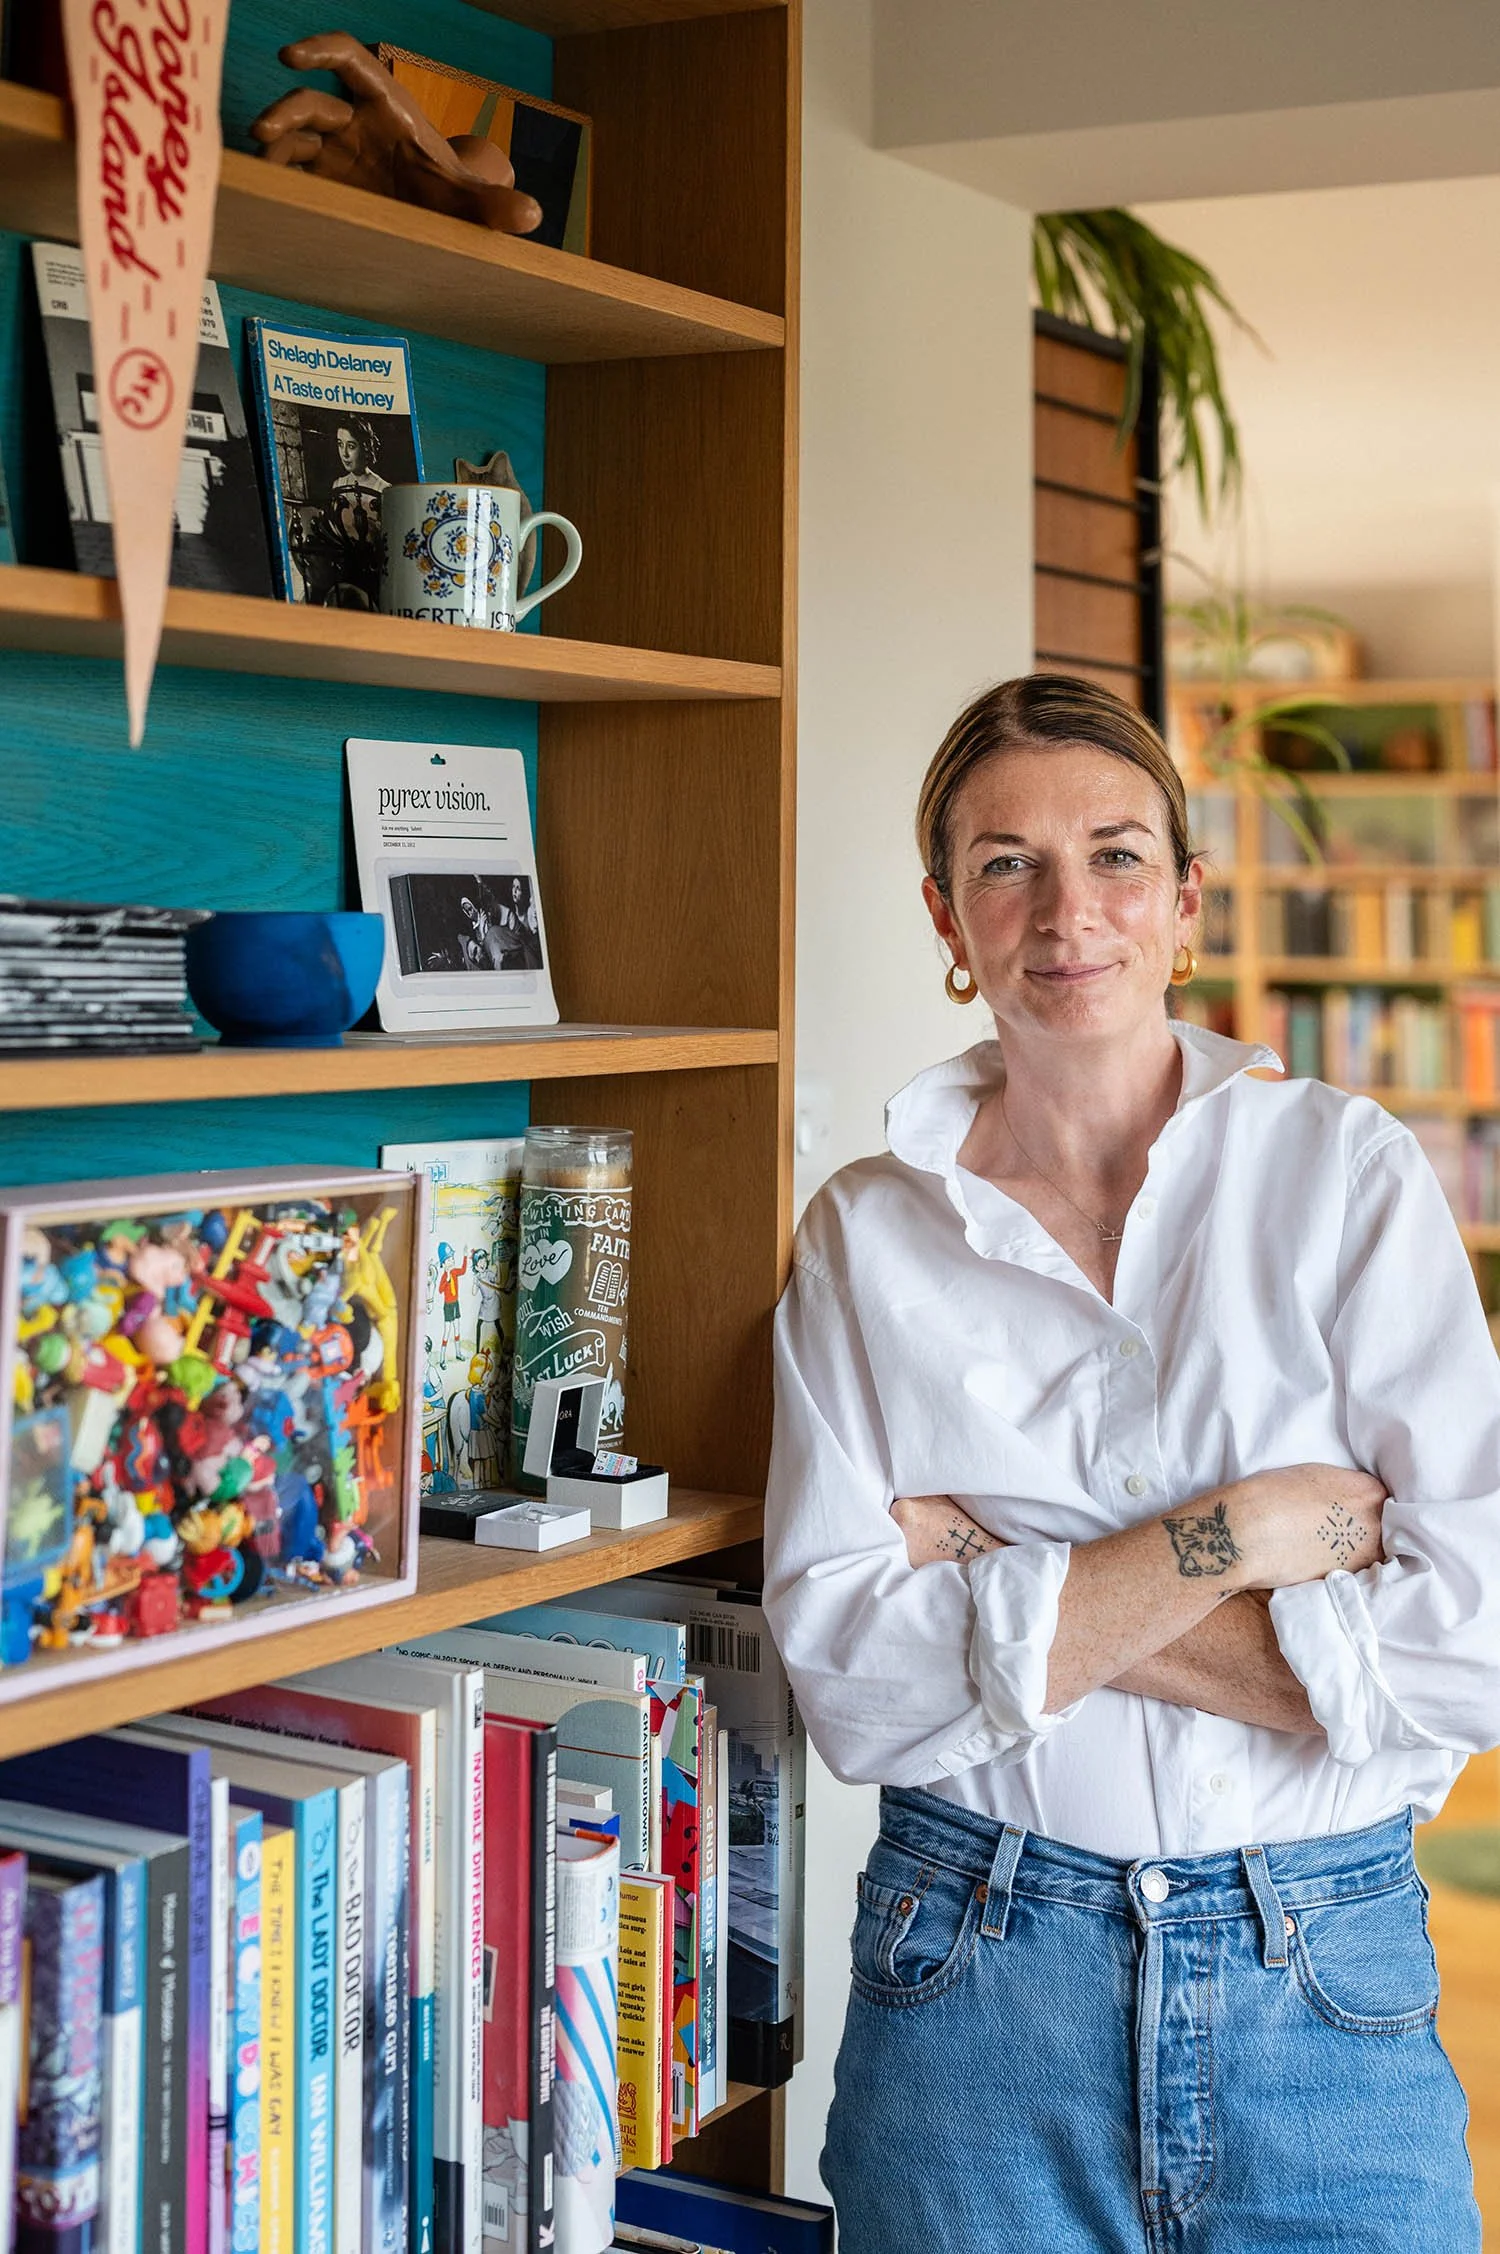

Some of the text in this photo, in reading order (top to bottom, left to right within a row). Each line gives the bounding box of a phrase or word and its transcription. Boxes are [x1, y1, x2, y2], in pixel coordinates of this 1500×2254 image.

[268, 339, 392, 377] Shelagh Delaney
[273, 374, 394, 411] A Taste of Honey
[389, 607, 475, 627] BERTY
[378, 781, 491, 815] pyrex vision.
[529, 1203, 597, 1221] WISHING
[539, 1227, 551, 1241] IN
[521, 1248, 569, 1277] Love
[538, 1305, 575, 1339] wish
[597, 1304, 609, 1314] TEN
[522, 1342, 595, 1389] FAST LUCK
[472, 1750, 483, 1844] INVISIBLE
[640, 1711, 650, 1854] CHARLES BUKOWSKI
[704, 1804, 714, 1969] GENDER QUEER
[344, 1892, 362, 1950] BAD
[472, 1851, 483, 1979] DIFFERENCES
[310, 1911, 329, 1971] LADY
[634, 1950, 646, 1958] and
[623, 1957, 638, 1967] sales
[631, 1983, 646, 1993] girls
[310, 1976, 329, 2064] DOCTOR
[343, 1953, 362, 2059] DOCTOR
[622, 2046, 645, 2057] answer
[631, 2038, 646, 2047] asks
[307, 2071, 328, 2254] IAN WILLIAMS
